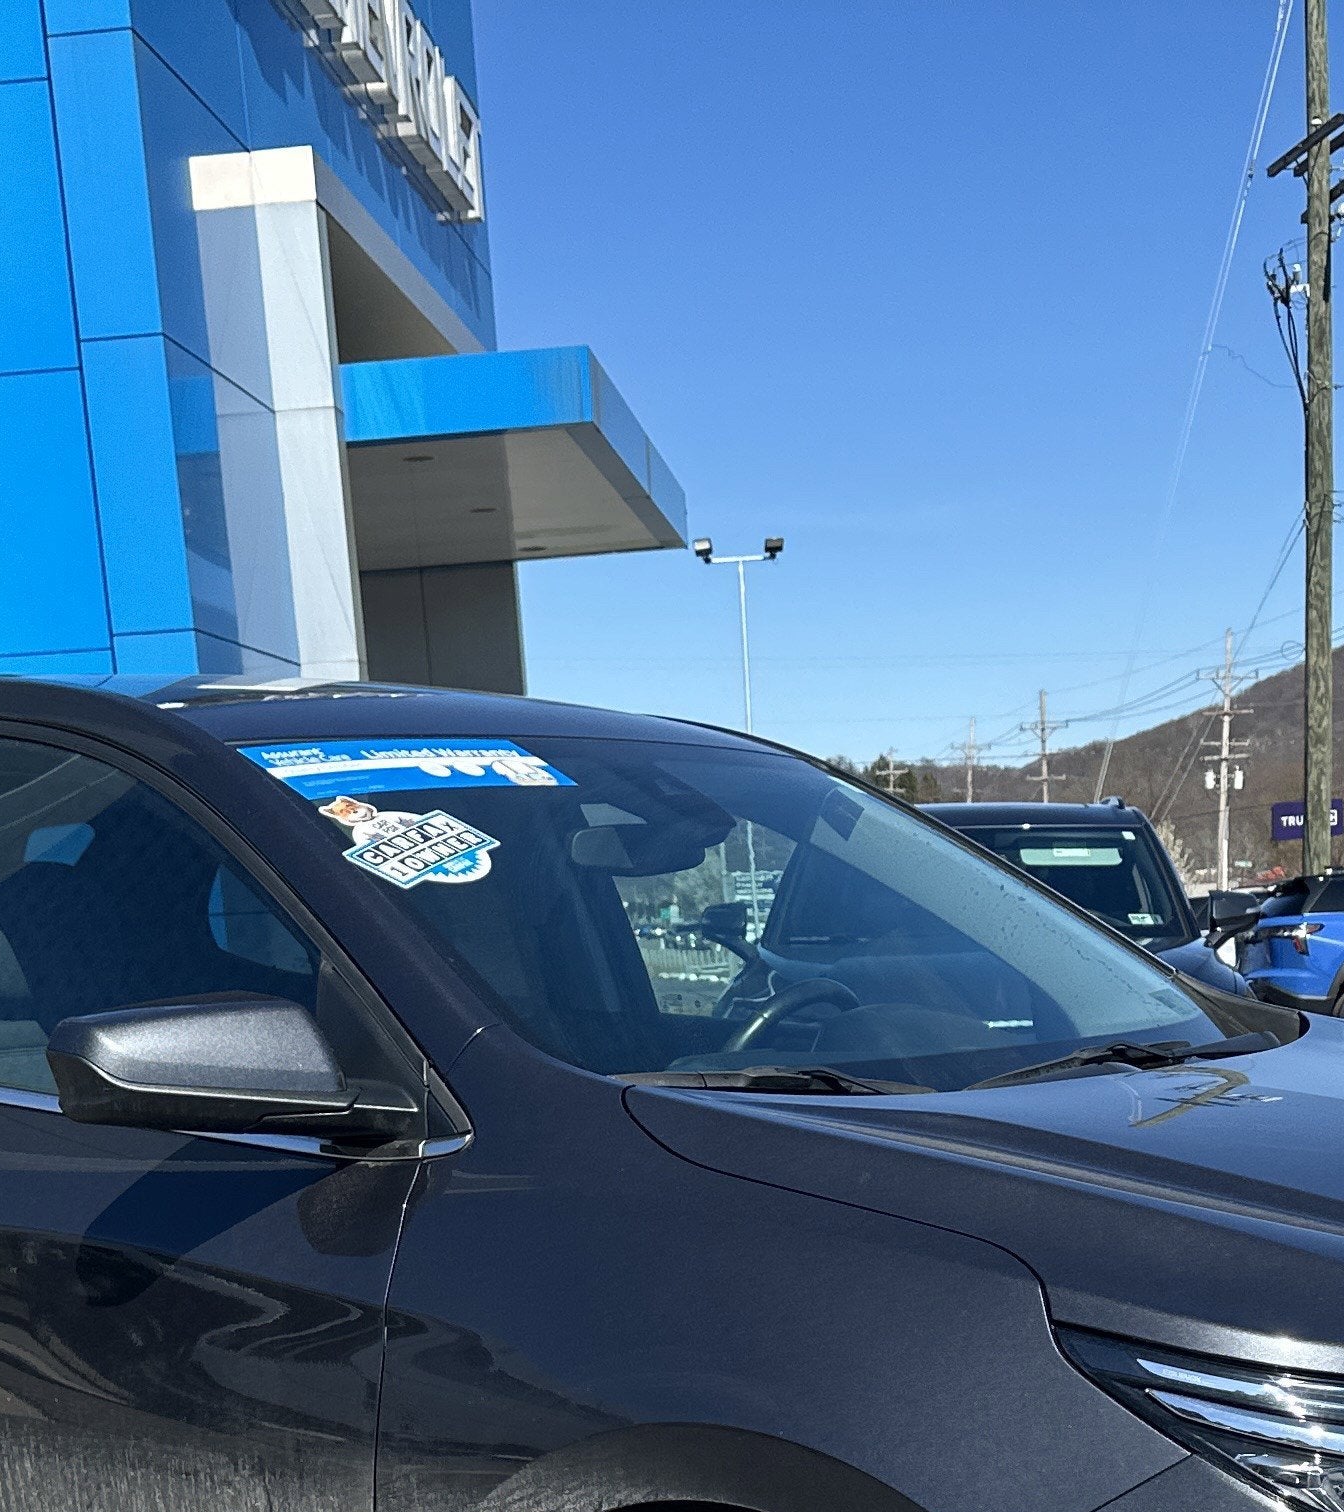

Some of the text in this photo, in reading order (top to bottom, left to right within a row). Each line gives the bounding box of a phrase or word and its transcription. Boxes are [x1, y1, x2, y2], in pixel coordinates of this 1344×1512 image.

[1281, 815, 1304, 828] TRU
[362, 822, 458, 864] CARFAX
[403, 830, 483, 871] OWNER
